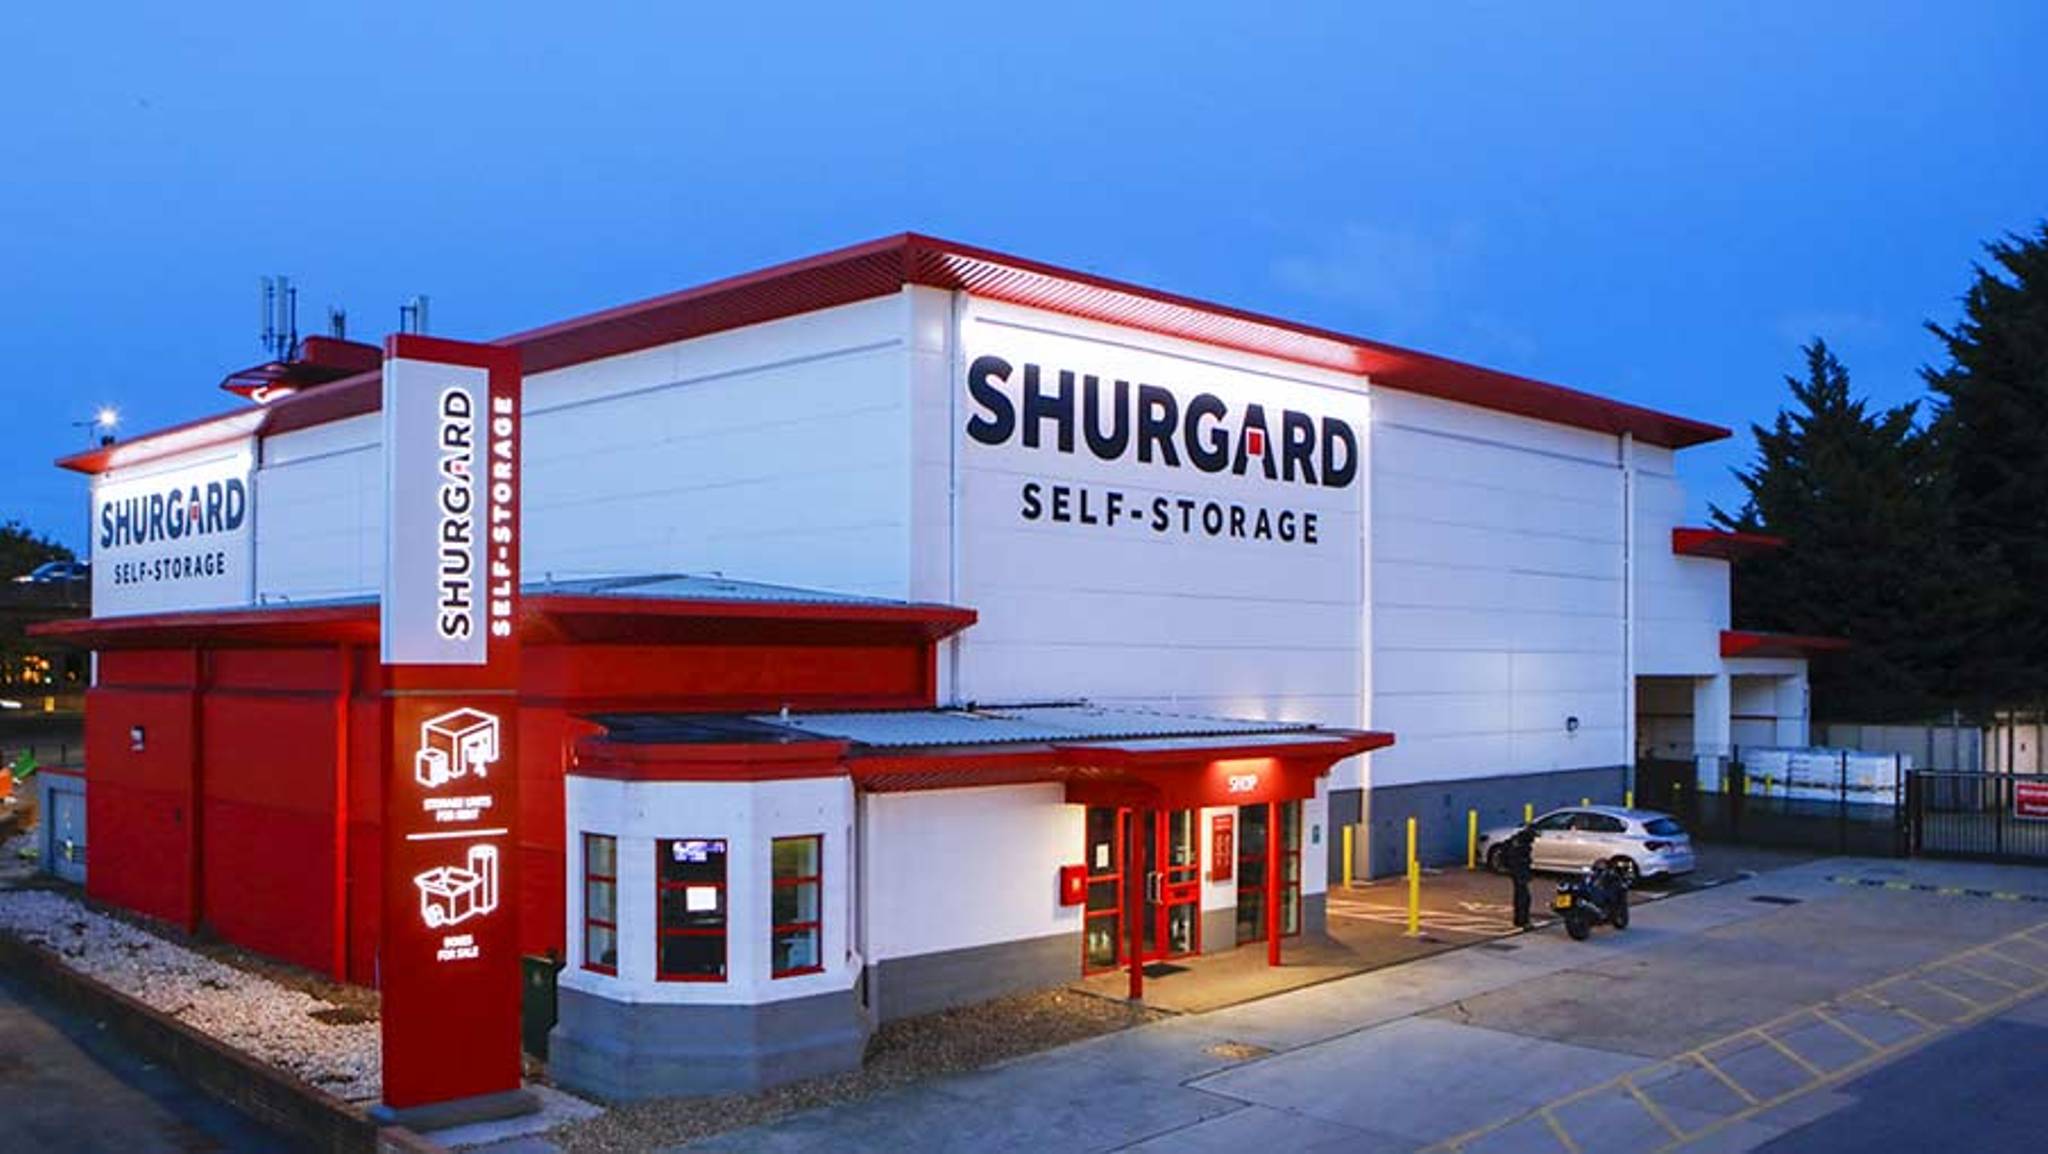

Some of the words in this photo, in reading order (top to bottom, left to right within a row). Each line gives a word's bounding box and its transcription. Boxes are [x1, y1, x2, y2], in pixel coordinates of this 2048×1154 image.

[966, 355, 1359, 489] SHURGARD
[100, 477, 246, 549] SHURGARD
[442, 391, 471, 637] SHURGARD
[492, 396, 514, 637] SELF-STORAGE
[1021, 482, 1319, 545] SELF-STORAGE
[114, 551, 226, 586] SELF-STORAGE
